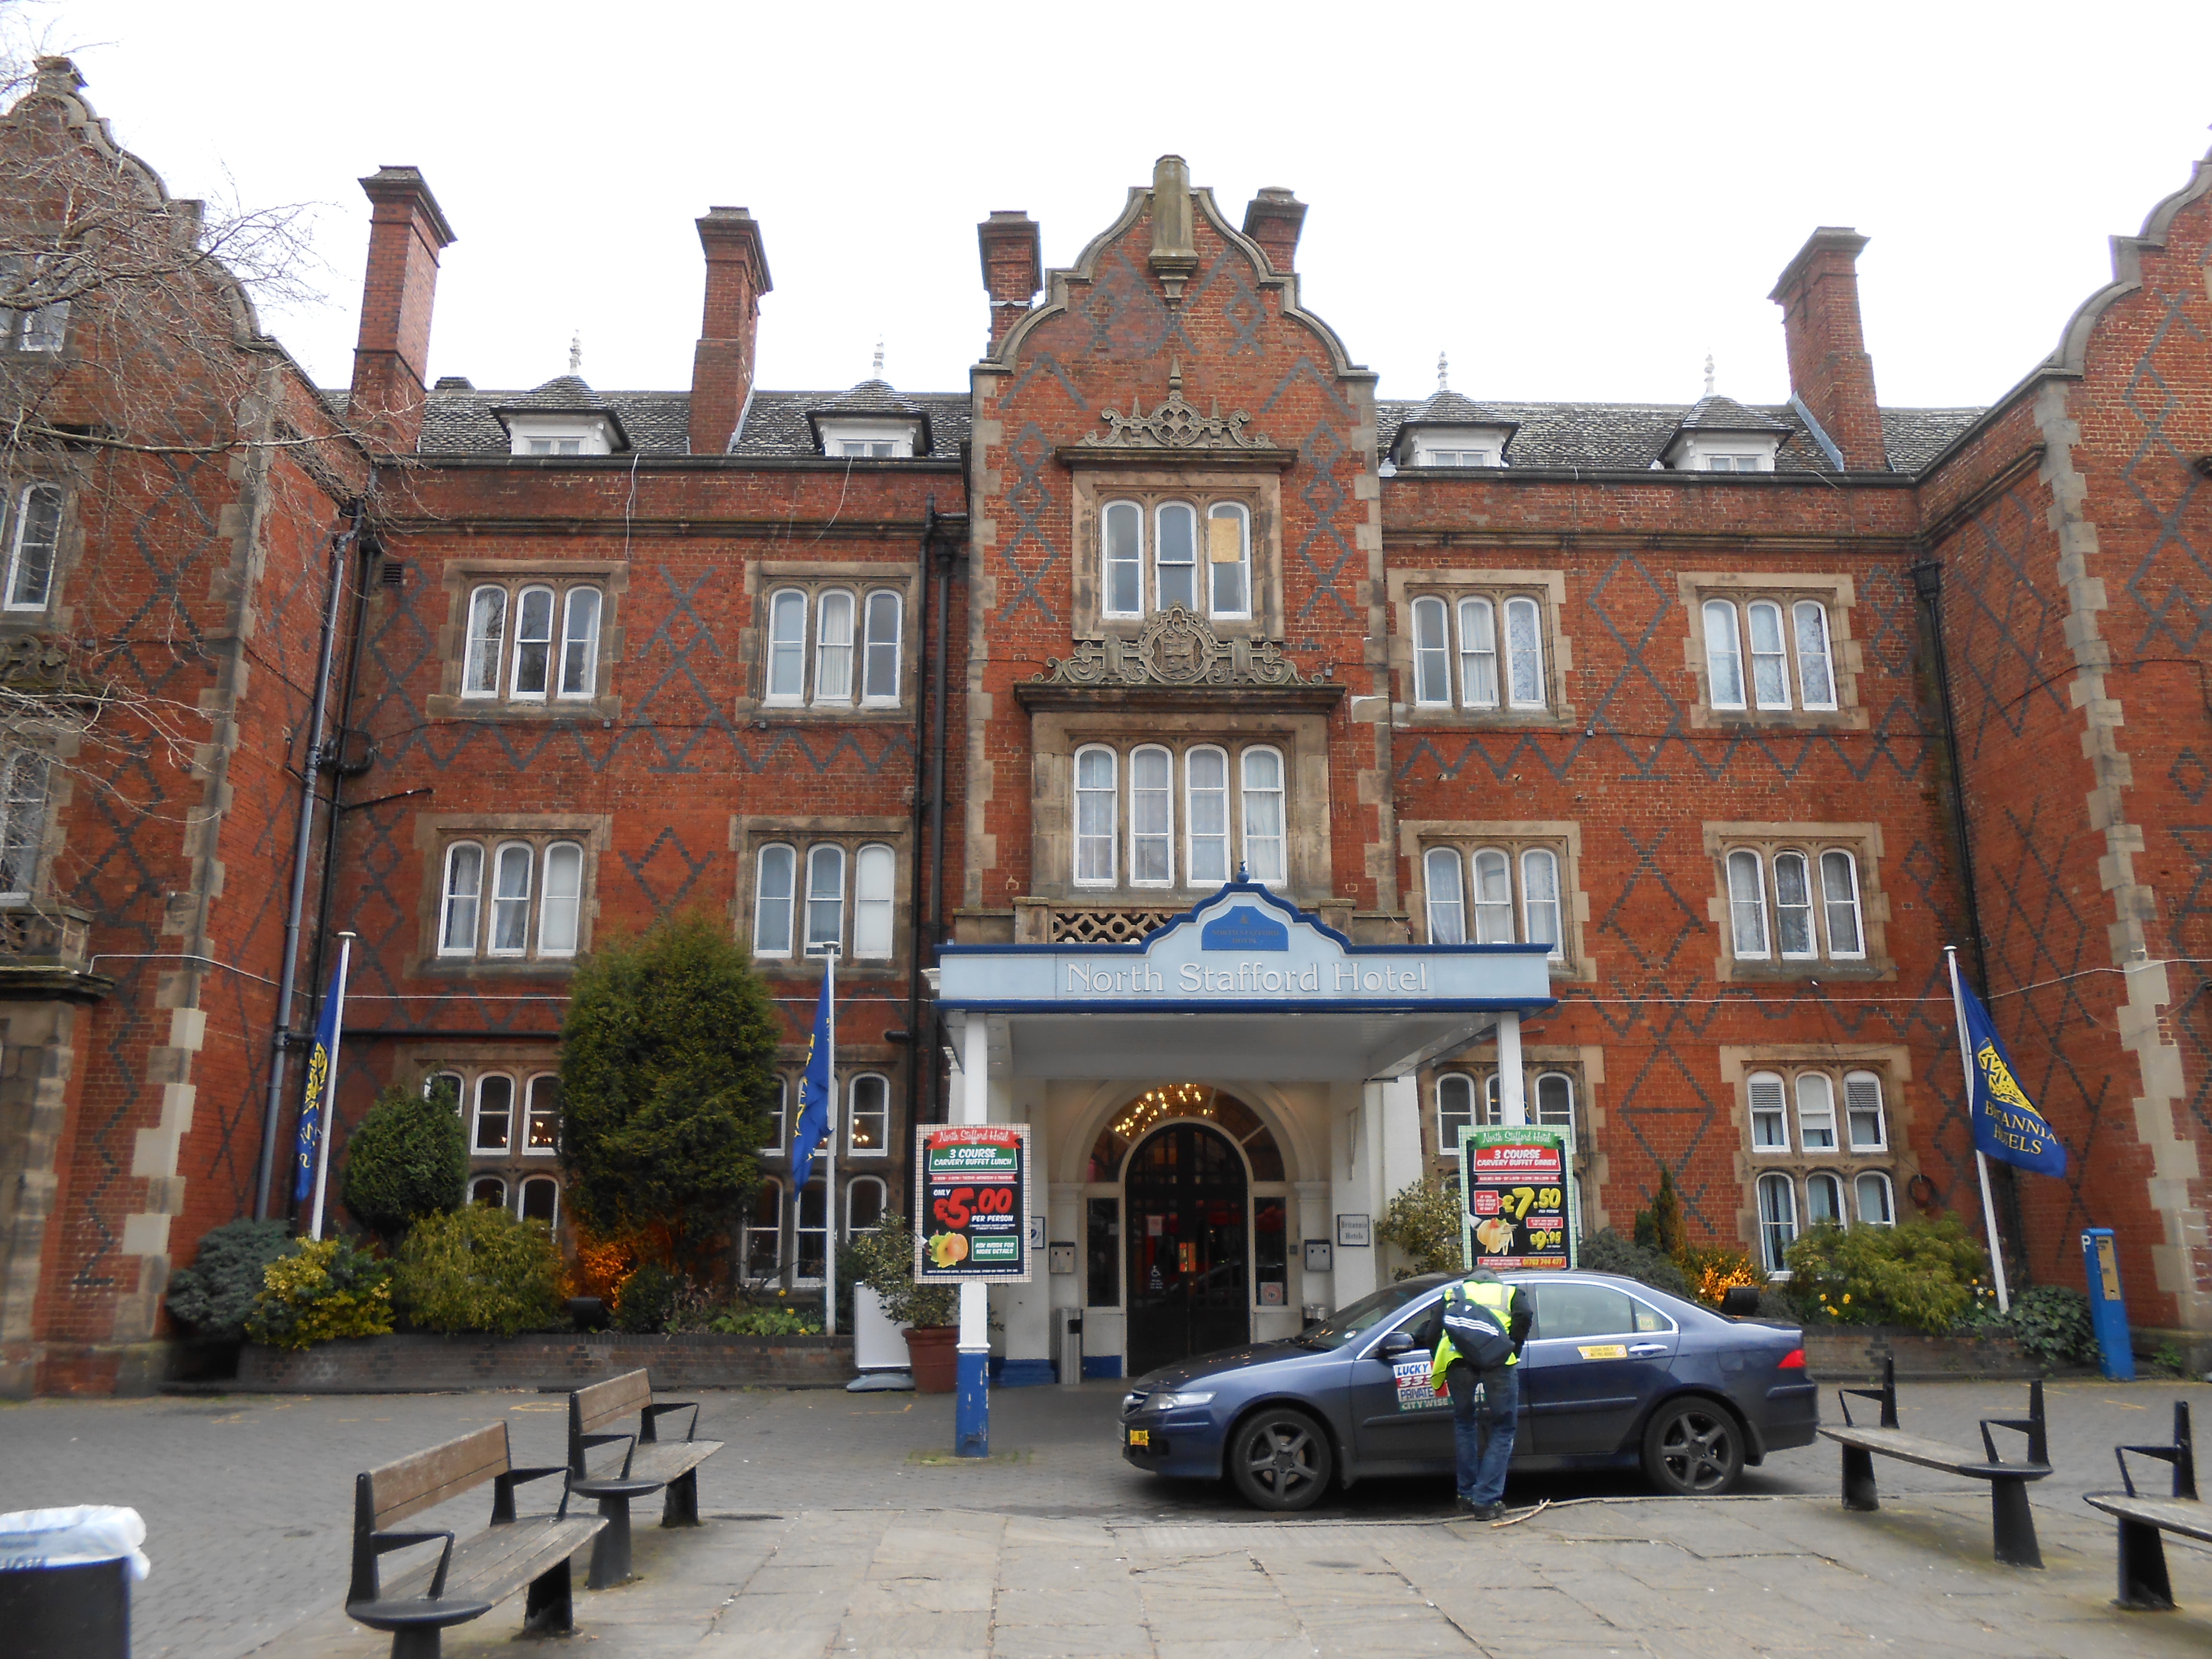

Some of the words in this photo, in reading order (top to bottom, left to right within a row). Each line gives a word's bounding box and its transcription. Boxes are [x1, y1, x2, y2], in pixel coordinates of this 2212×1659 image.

[1066, 963, 1164, 992] North
[1179, 962, 1320, 992] Stafford
[1333, 962, 1427, 992] Hotel
[1985, 1100, 2057, 1145] BTANNIA
[938, 1131, 959, 1142] North
[961, 1130, 988, 1144] Stafford
[990, 1130, 1009, 1142] Hotel
[1482, 1132, 1503, 1143] North
[1505, 1131, 1531, 1145] Stafford
[1534, 1131, 1551, 1142] Hotel
[949, 1149, 956, 1158] 3
[959, 1148, 997, 1158] COURSE
[1494, 1150, 1501, 1159] 3
[1503, 1150, 1541, 1159] COURSE
[934, 1187, 1013, 1229] £5.00
[1503, 1187, 1561, 1220] £7.50
[1530, 1231, 1562, 1250] £9.95
[1397, 1364, 1429, 1376] LUCKY
[1401, 1387, 1434, 1399] PRIVATE
[1402, 1398, 1448, 1410] CITYWISE
